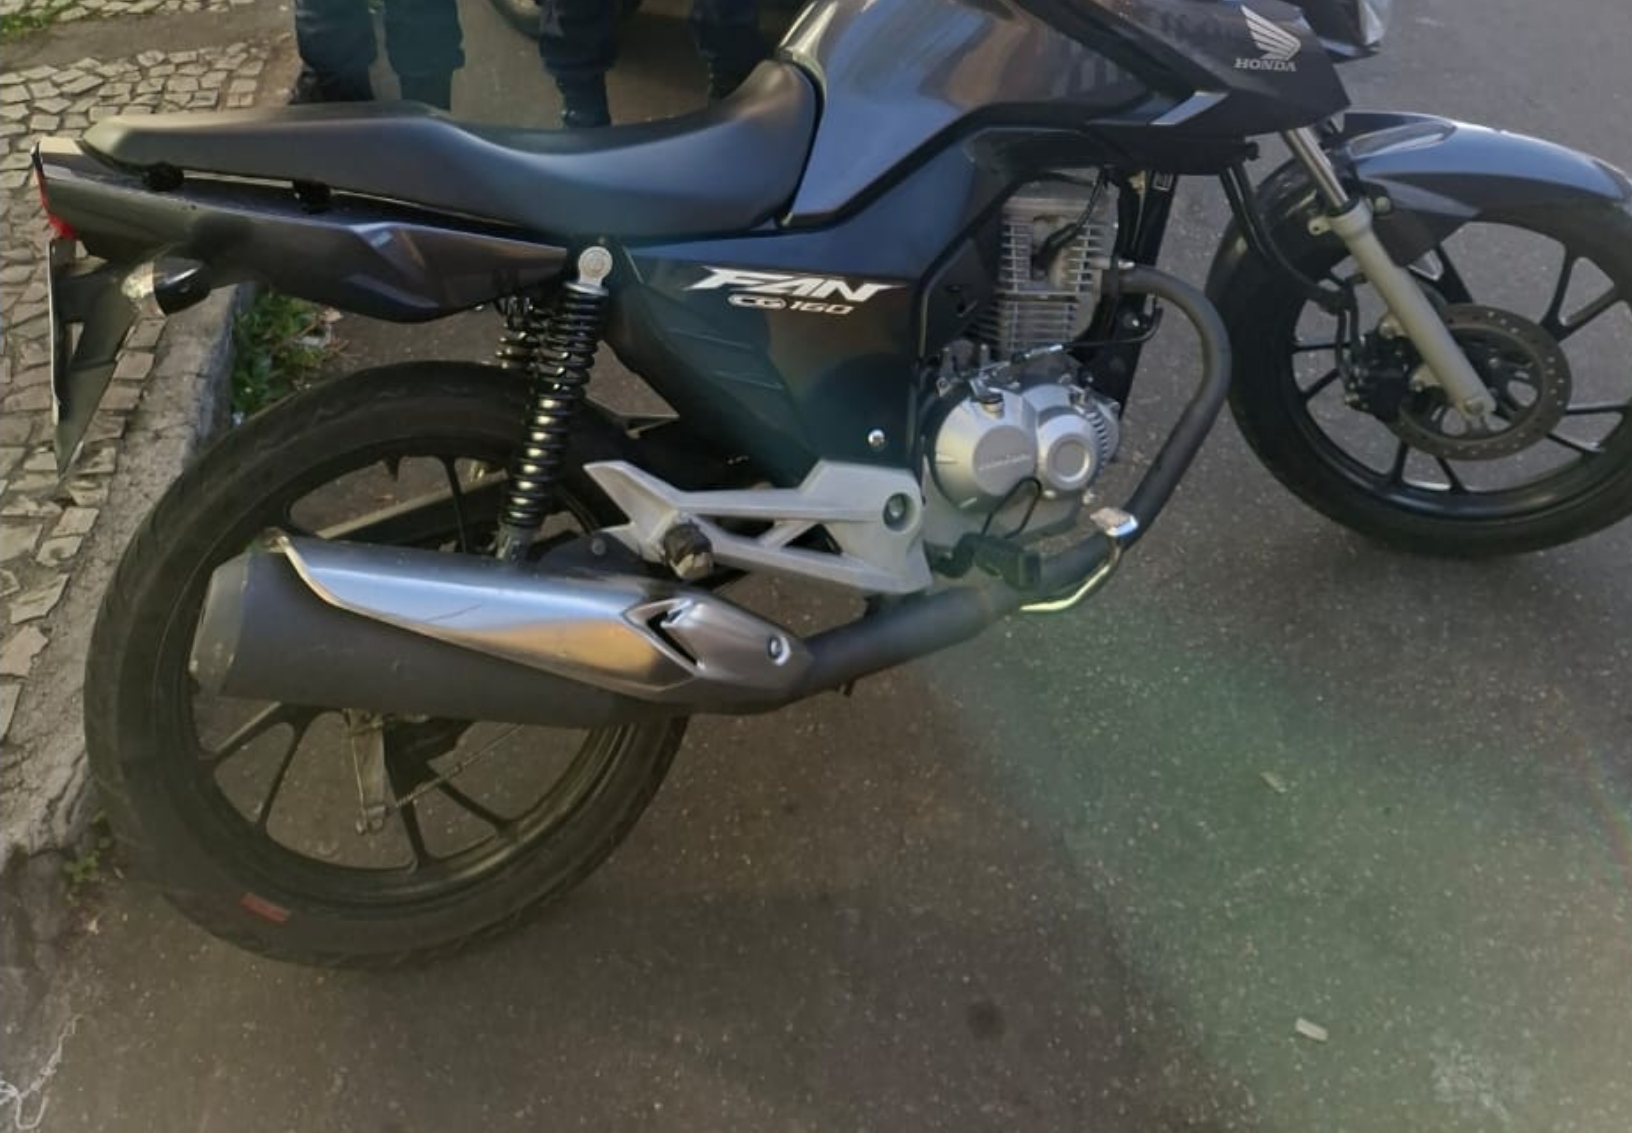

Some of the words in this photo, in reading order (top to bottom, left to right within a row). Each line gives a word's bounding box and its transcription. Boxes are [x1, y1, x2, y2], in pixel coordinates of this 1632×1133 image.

[1234, 56, 1297, 72] HONDA
[685, 266, 900, 302] FAN
[727, 293, 787, 310] CG
[789, 300, 855, 315] 160
